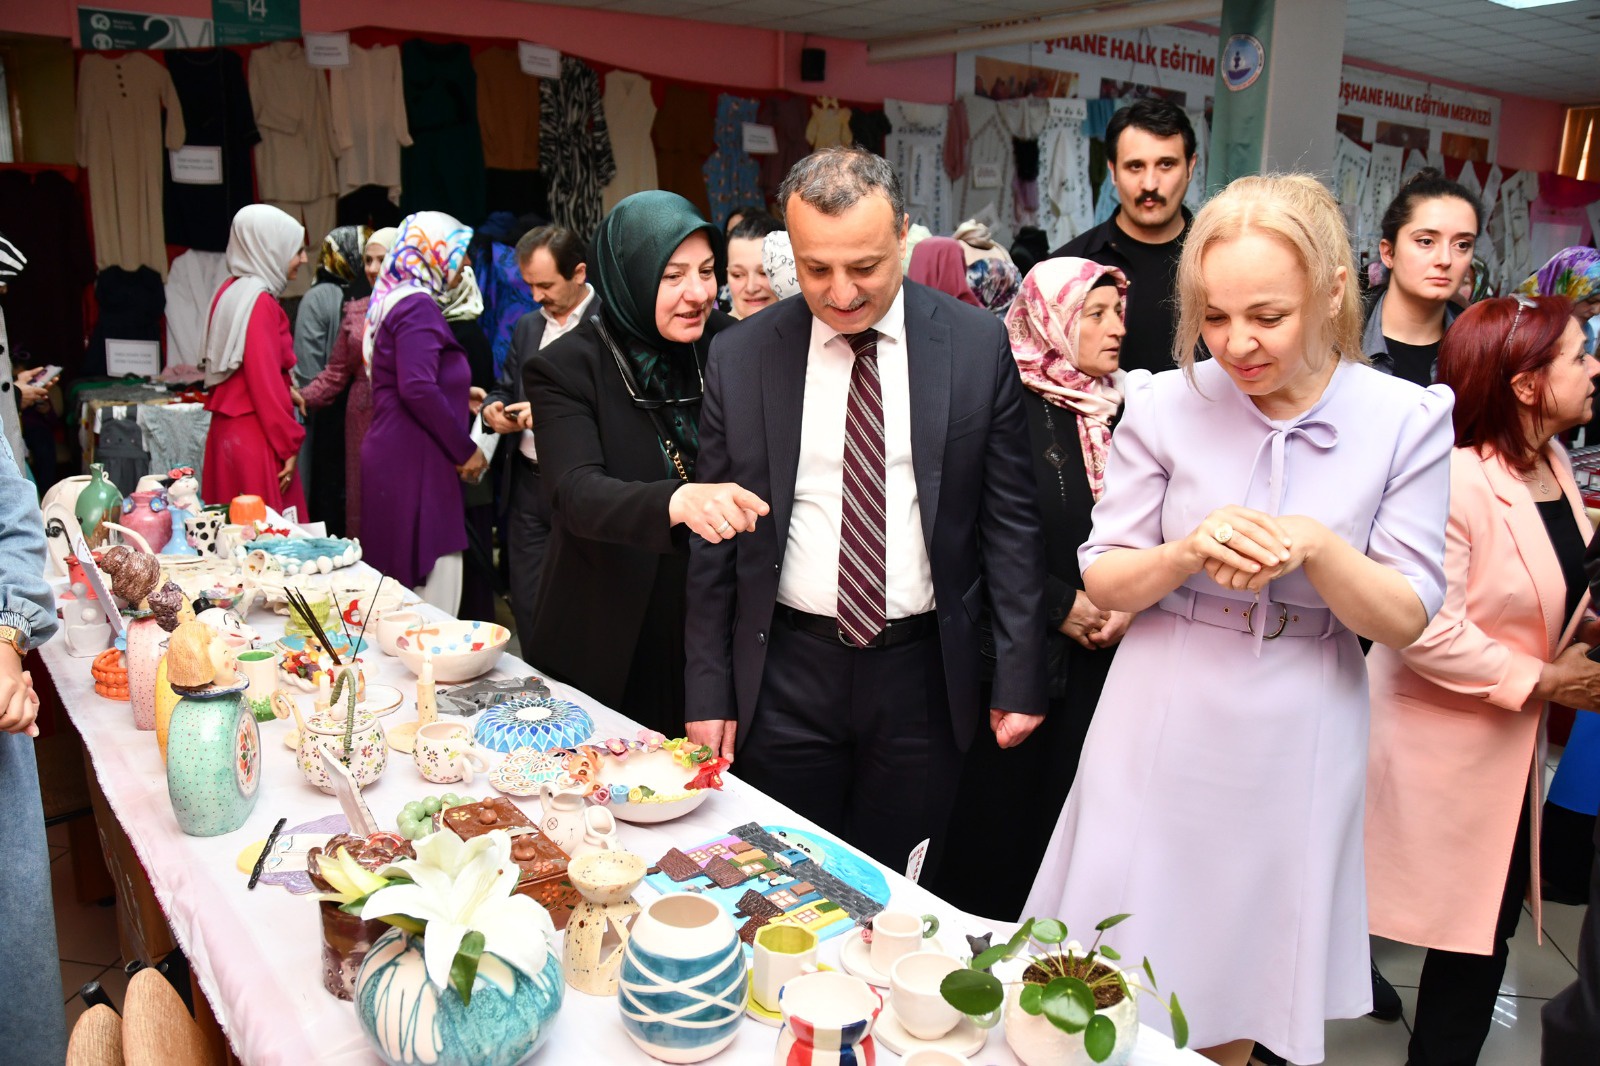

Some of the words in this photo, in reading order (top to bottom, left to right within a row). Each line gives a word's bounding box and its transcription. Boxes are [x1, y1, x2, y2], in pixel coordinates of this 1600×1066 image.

[1110, 38, 1157, 66] HALK
[1160, 42, 1215, 76] EĞİTİM
[1384, 90, 1414, 112] HALK
[1415, 93, 1450, 119] EĞİTİM
[1451, 103, 1491, 126] MERKEZİ
